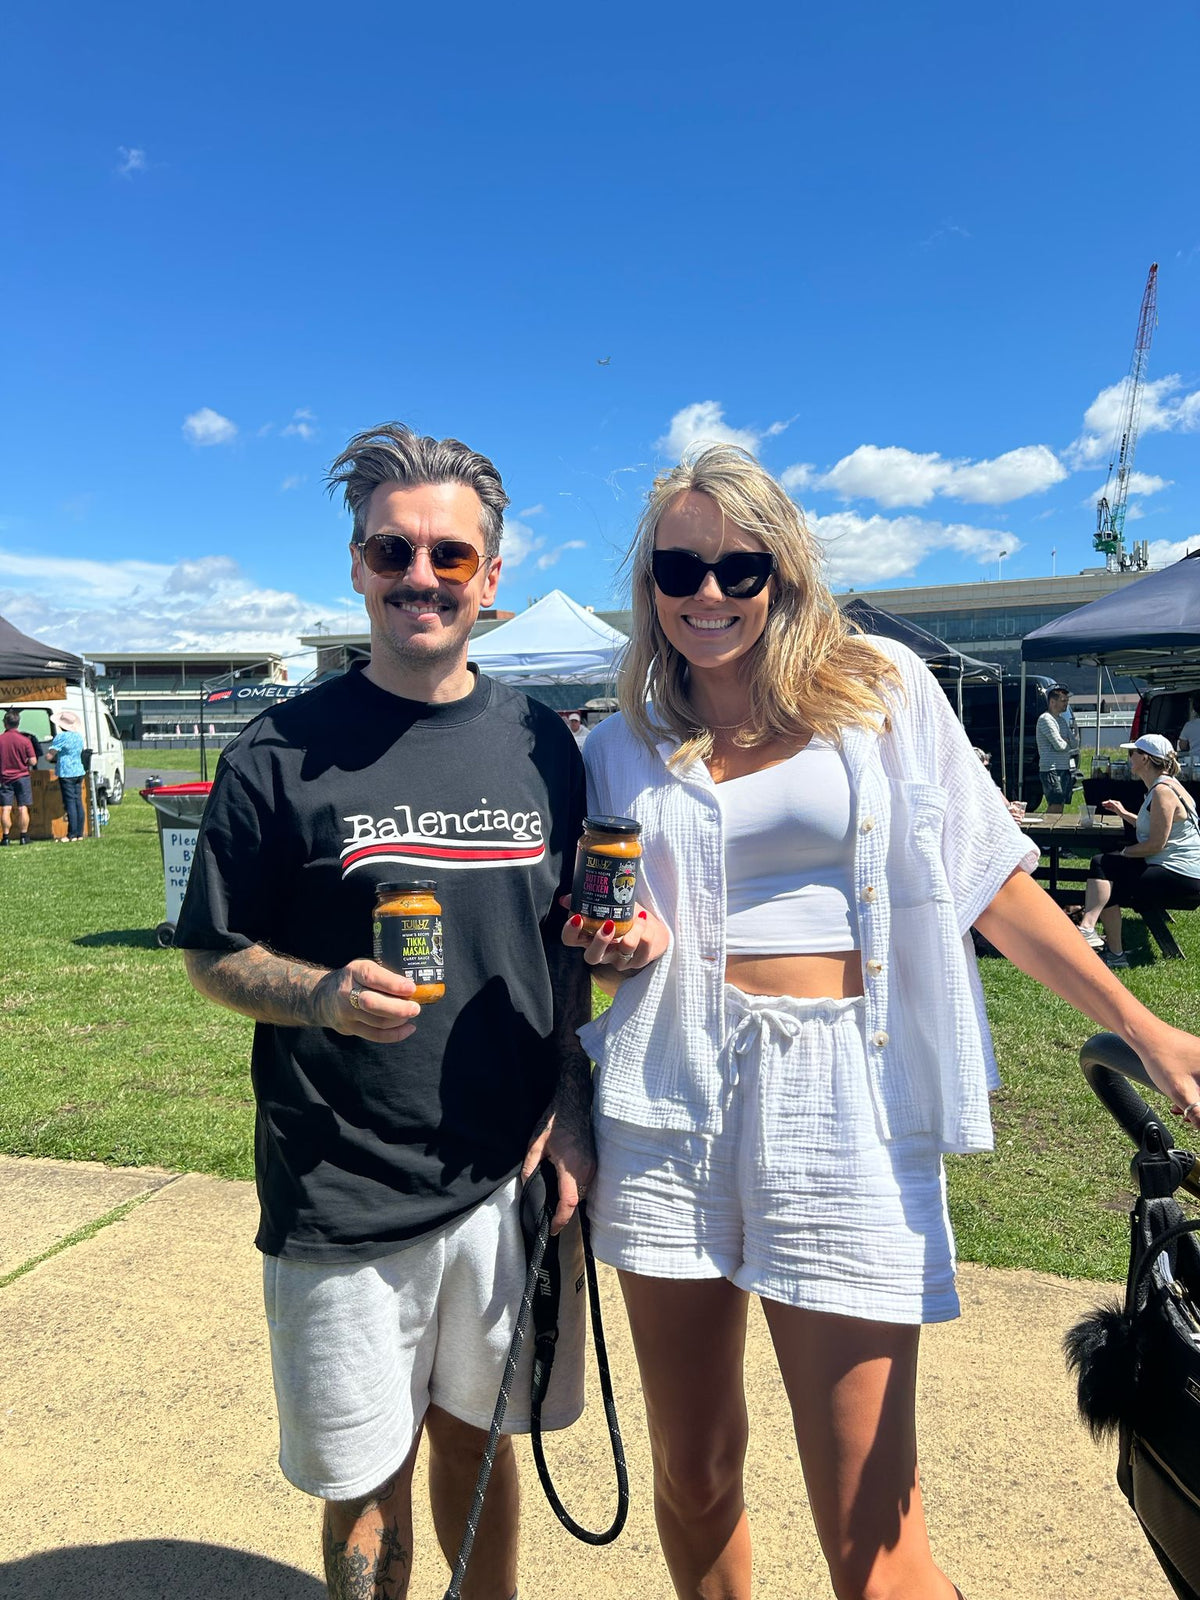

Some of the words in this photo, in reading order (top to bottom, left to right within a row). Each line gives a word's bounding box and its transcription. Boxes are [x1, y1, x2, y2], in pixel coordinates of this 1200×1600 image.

[0, 686, 33, 697] WOW
[343, 797, 542, 843] Balenciaga
[183, 850, 194, 862] B
[585, 874, 608, 885] BUTTER
[583, 882, 608, 894] CHICKEN
[406, 937, 427, 947] TIKKA
[402, 946, 430, 957] MASALA
